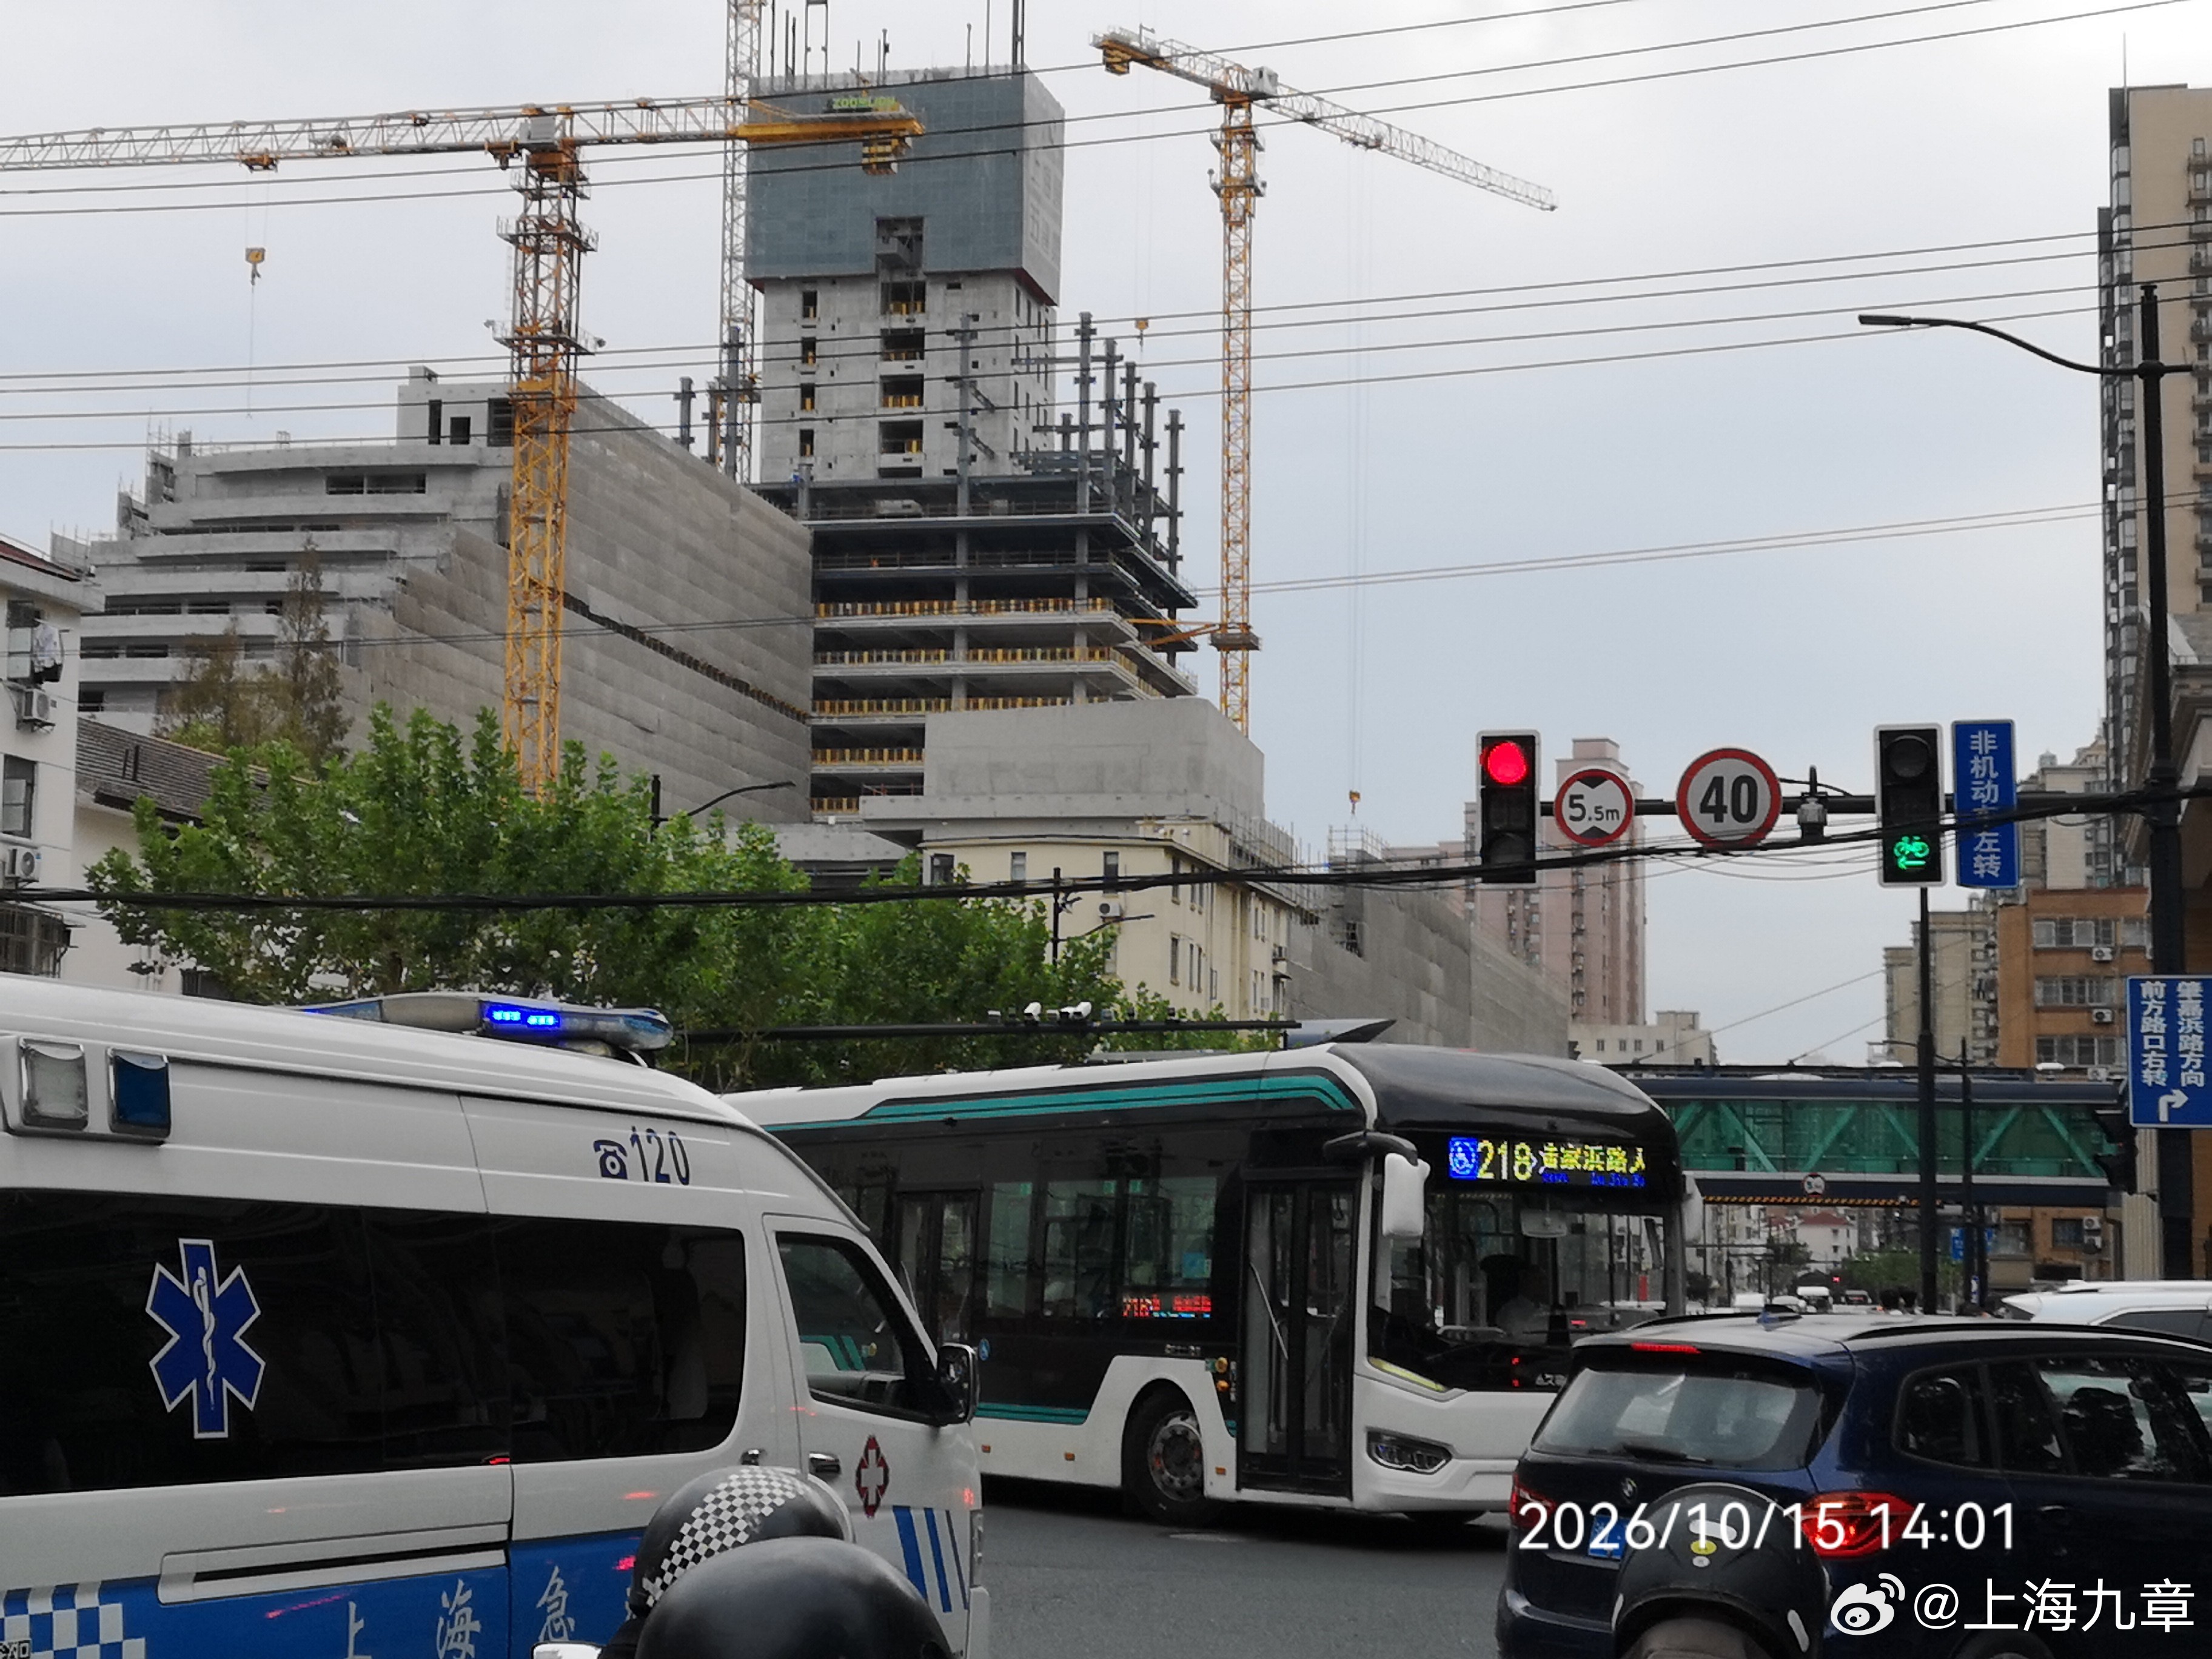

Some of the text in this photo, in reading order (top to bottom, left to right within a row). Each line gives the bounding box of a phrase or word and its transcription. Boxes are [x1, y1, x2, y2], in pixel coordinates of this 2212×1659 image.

[1568, 794, 1620, 822] 5.5m
[1700, 774, 1758, 823] 40
[2139, 980, 2168, 1087] 前方路口右转
[630, 1126, 690, 1185] 120
[1477, 1139, 1533, 1181] 218
[344, 1566, 635, 1659] 上海急
